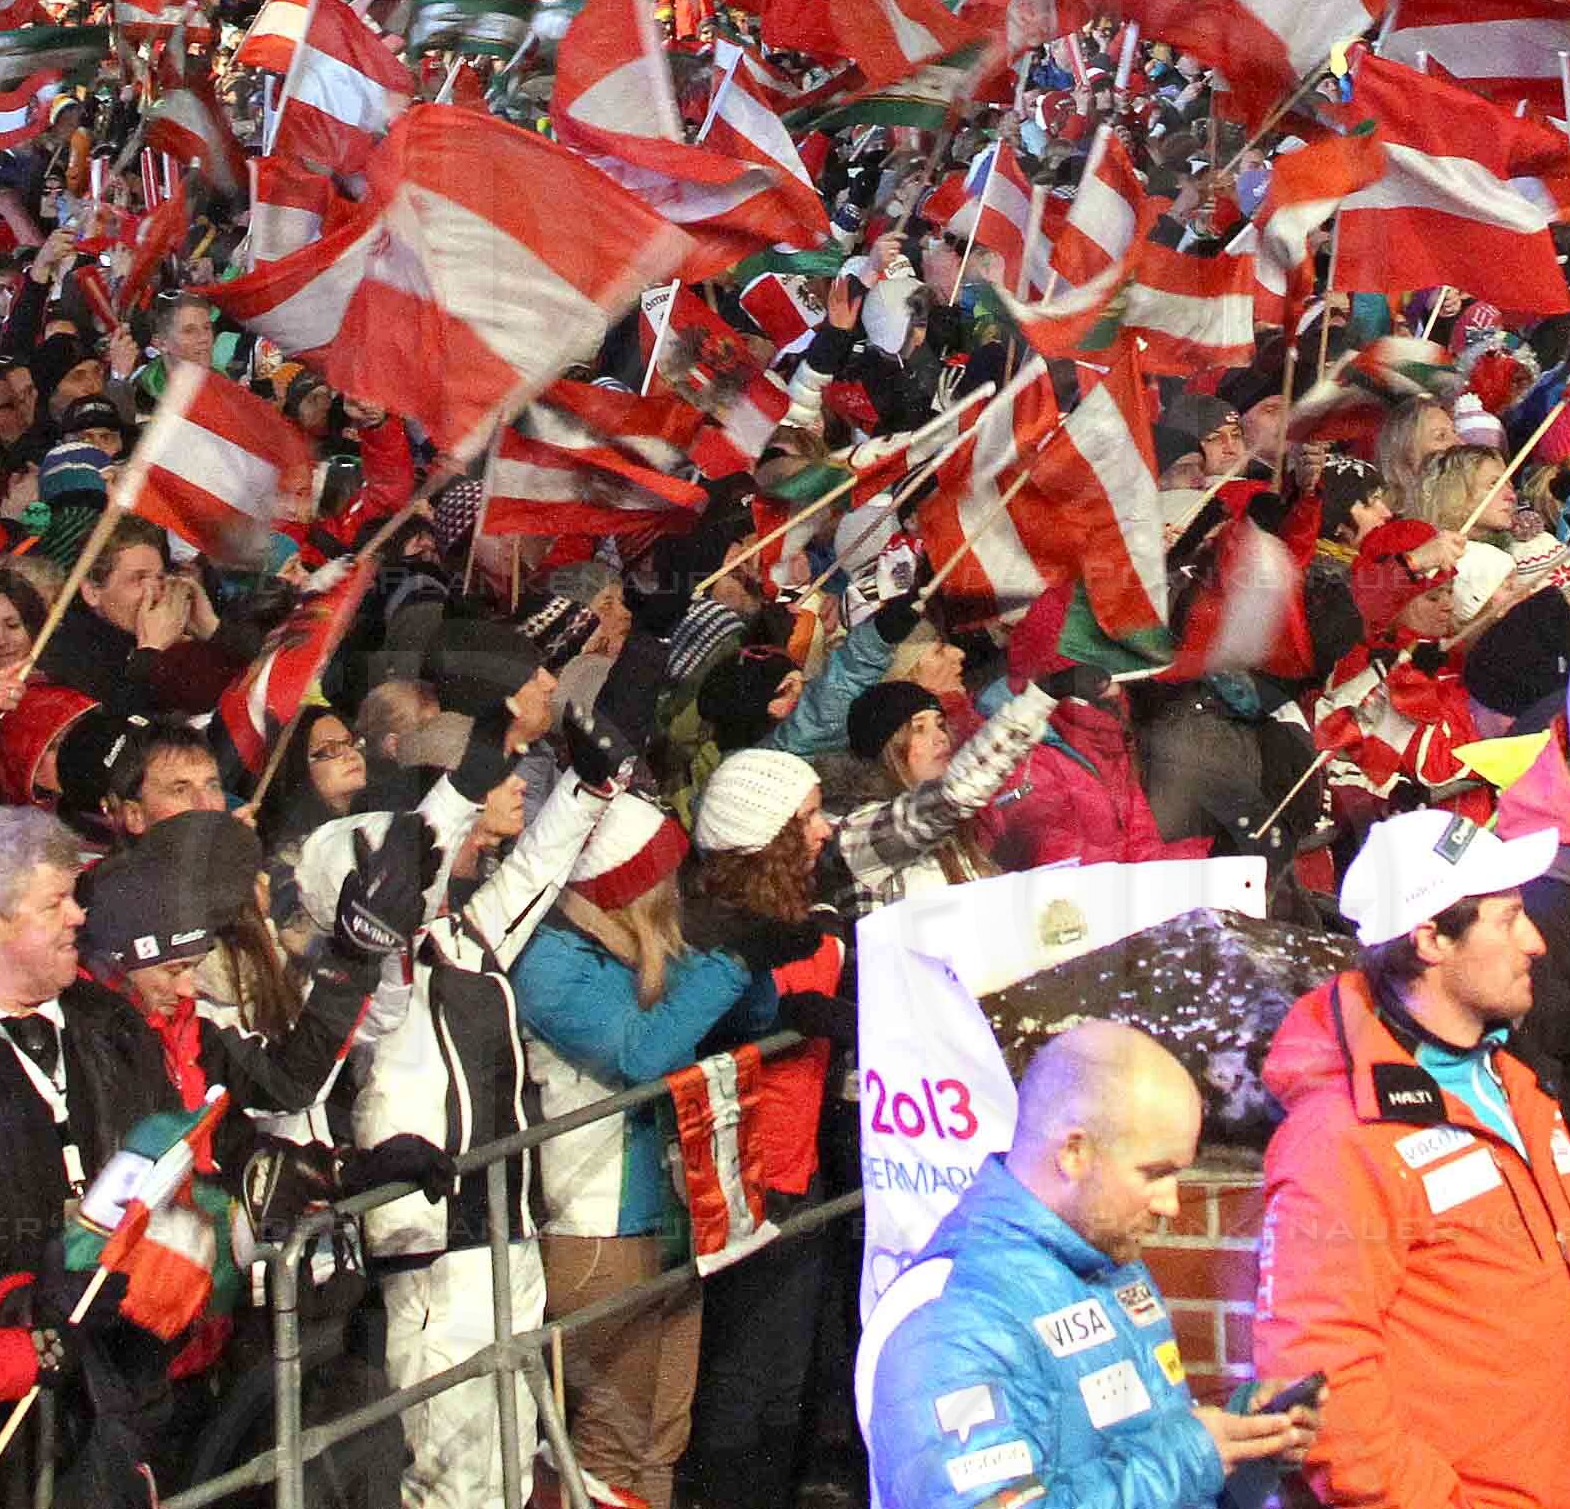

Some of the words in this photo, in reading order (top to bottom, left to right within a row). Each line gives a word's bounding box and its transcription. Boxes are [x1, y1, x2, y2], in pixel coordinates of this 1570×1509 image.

[866, 1069, 979, 1140] 2013
[1388, 1089, 1433, 1106] HALTI
[1046, 1307, 1107, 1348] VISA
